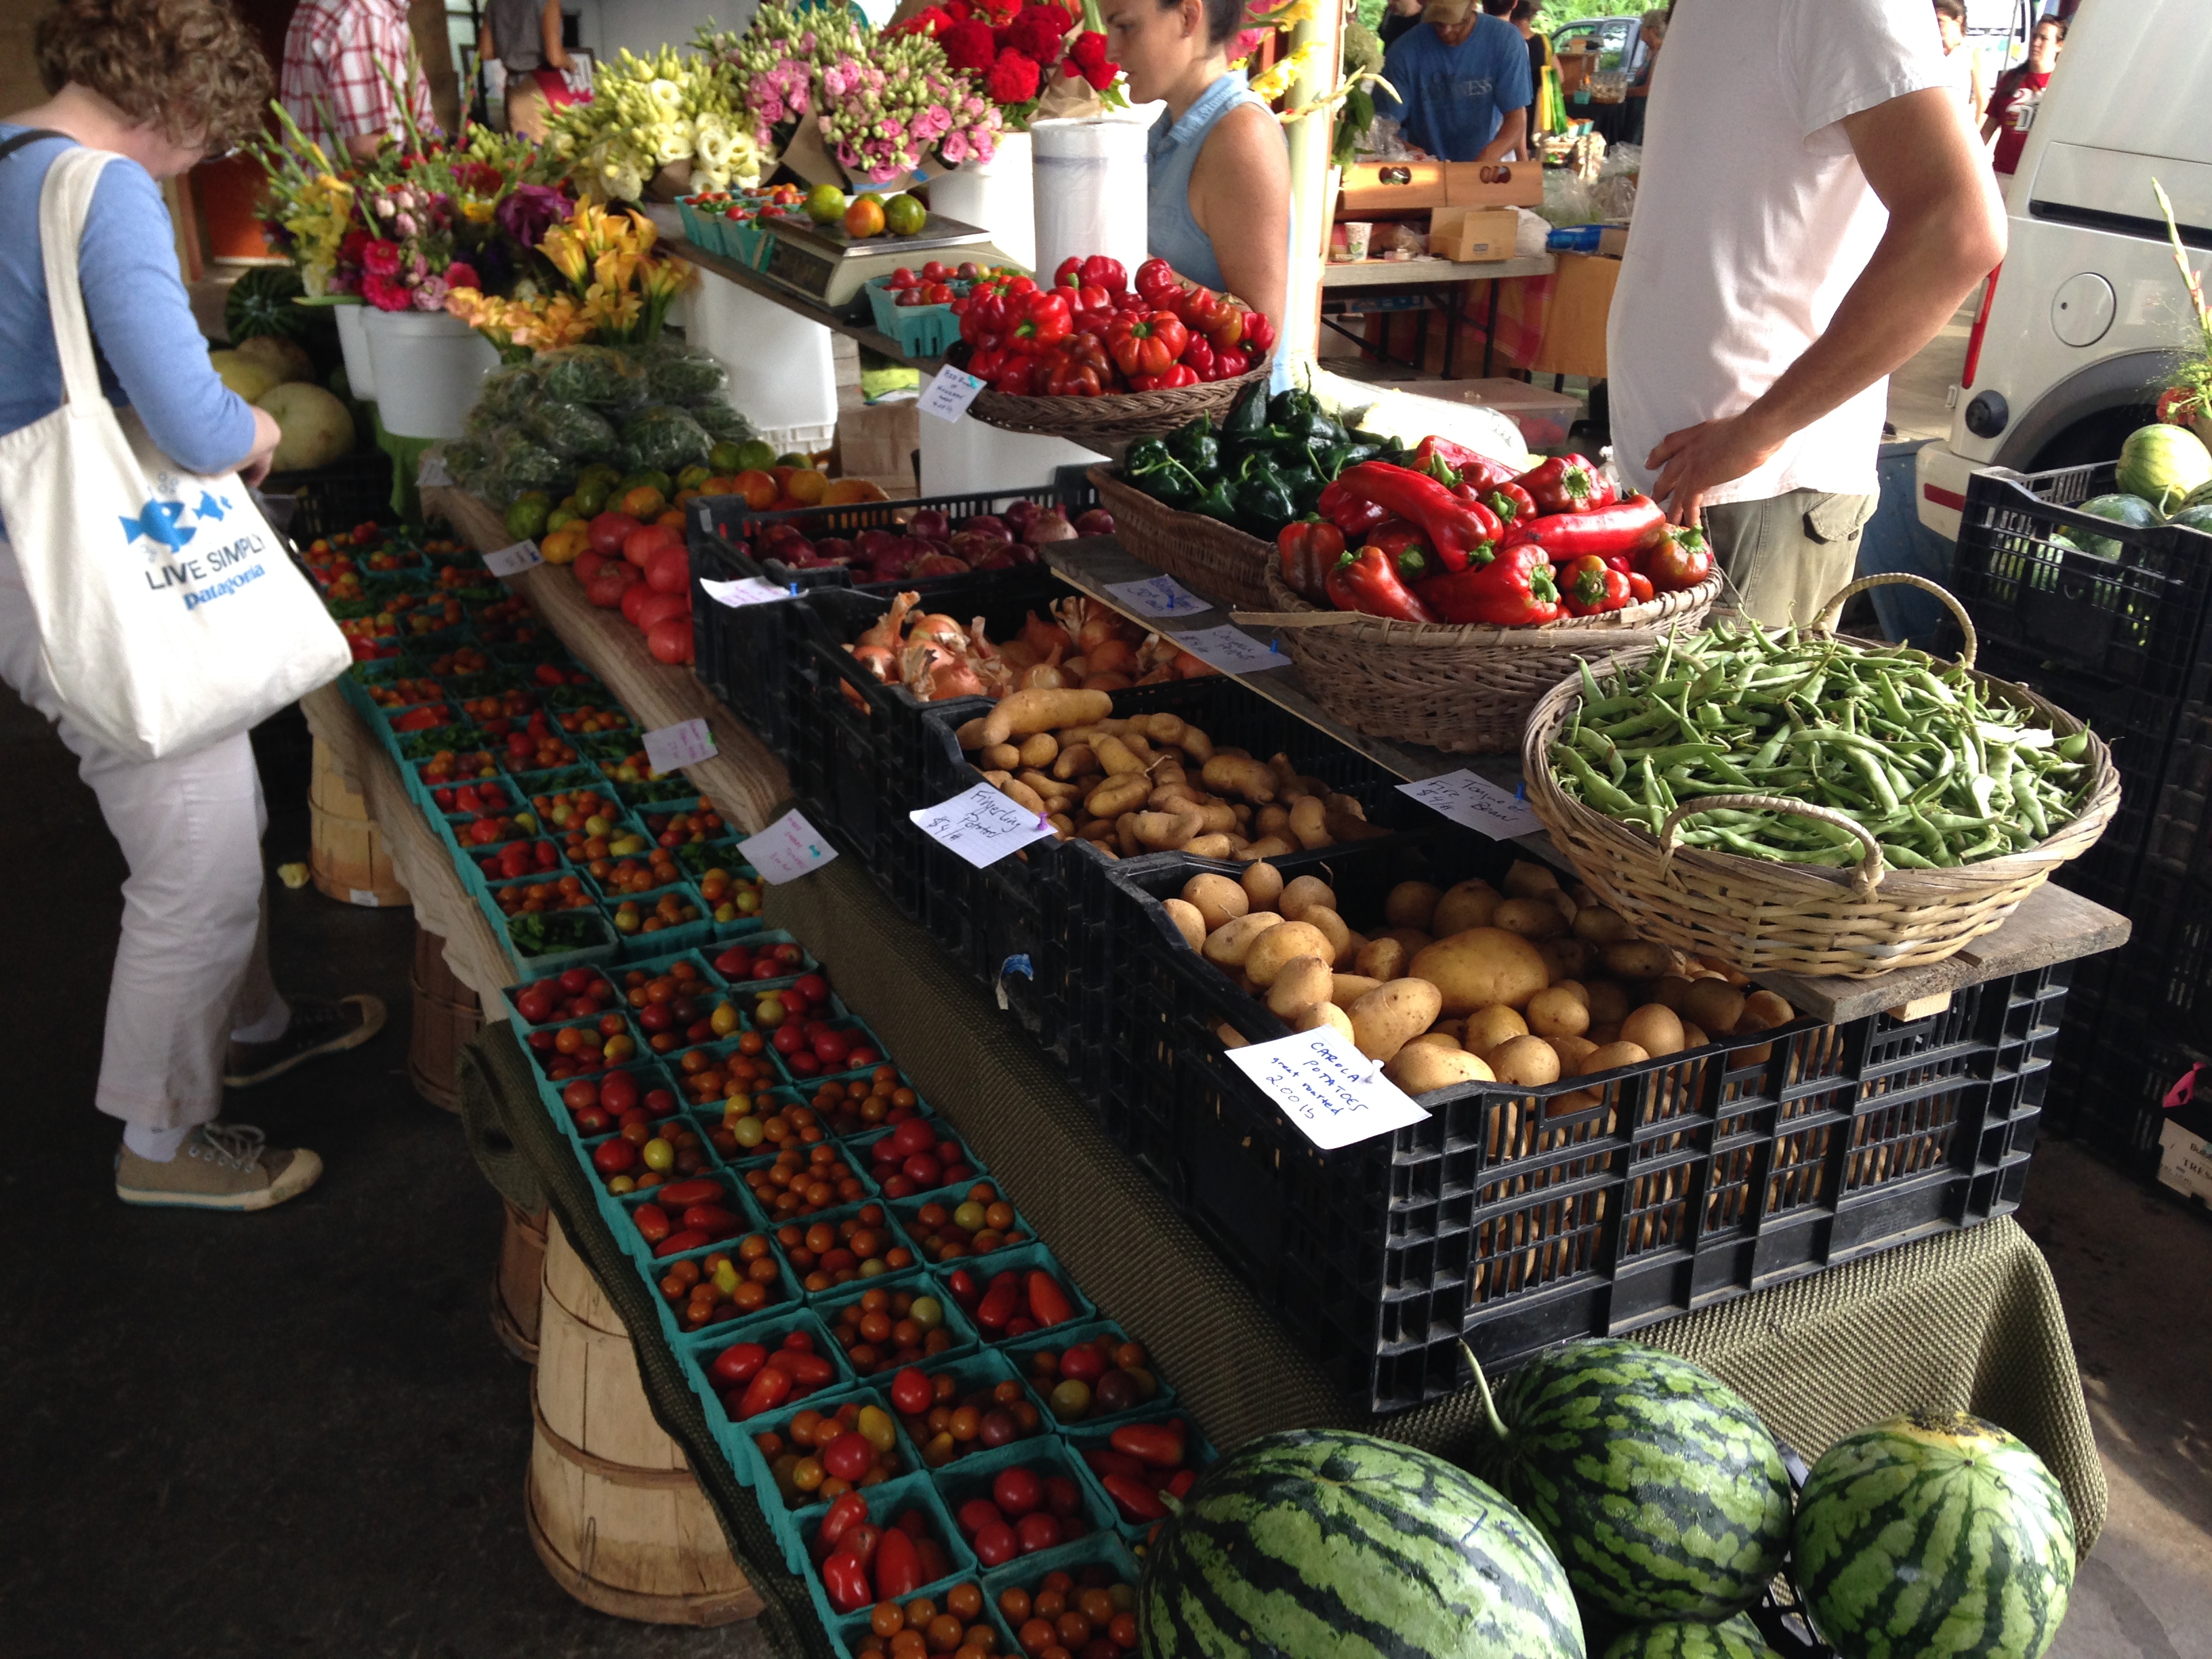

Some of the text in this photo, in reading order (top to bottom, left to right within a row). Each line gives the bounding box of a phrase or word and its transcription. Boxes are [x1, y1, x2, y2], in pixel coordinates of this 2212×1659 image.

[145, 560, 207, 590] LIVE
[970, 790, 1021, 833] Fingerling
[1428, 780, 1519, 821] Fire Beans
[1460, 779, 1505, 804] Tongue
[1311, 1042, 1360, 1083] CAROLA
[1265, 1075, 1300, 1103] 2.00
[1271, 1057, 1345, 1116] great roasted
[1303, 1060, 1369, 1111] POTATOES
